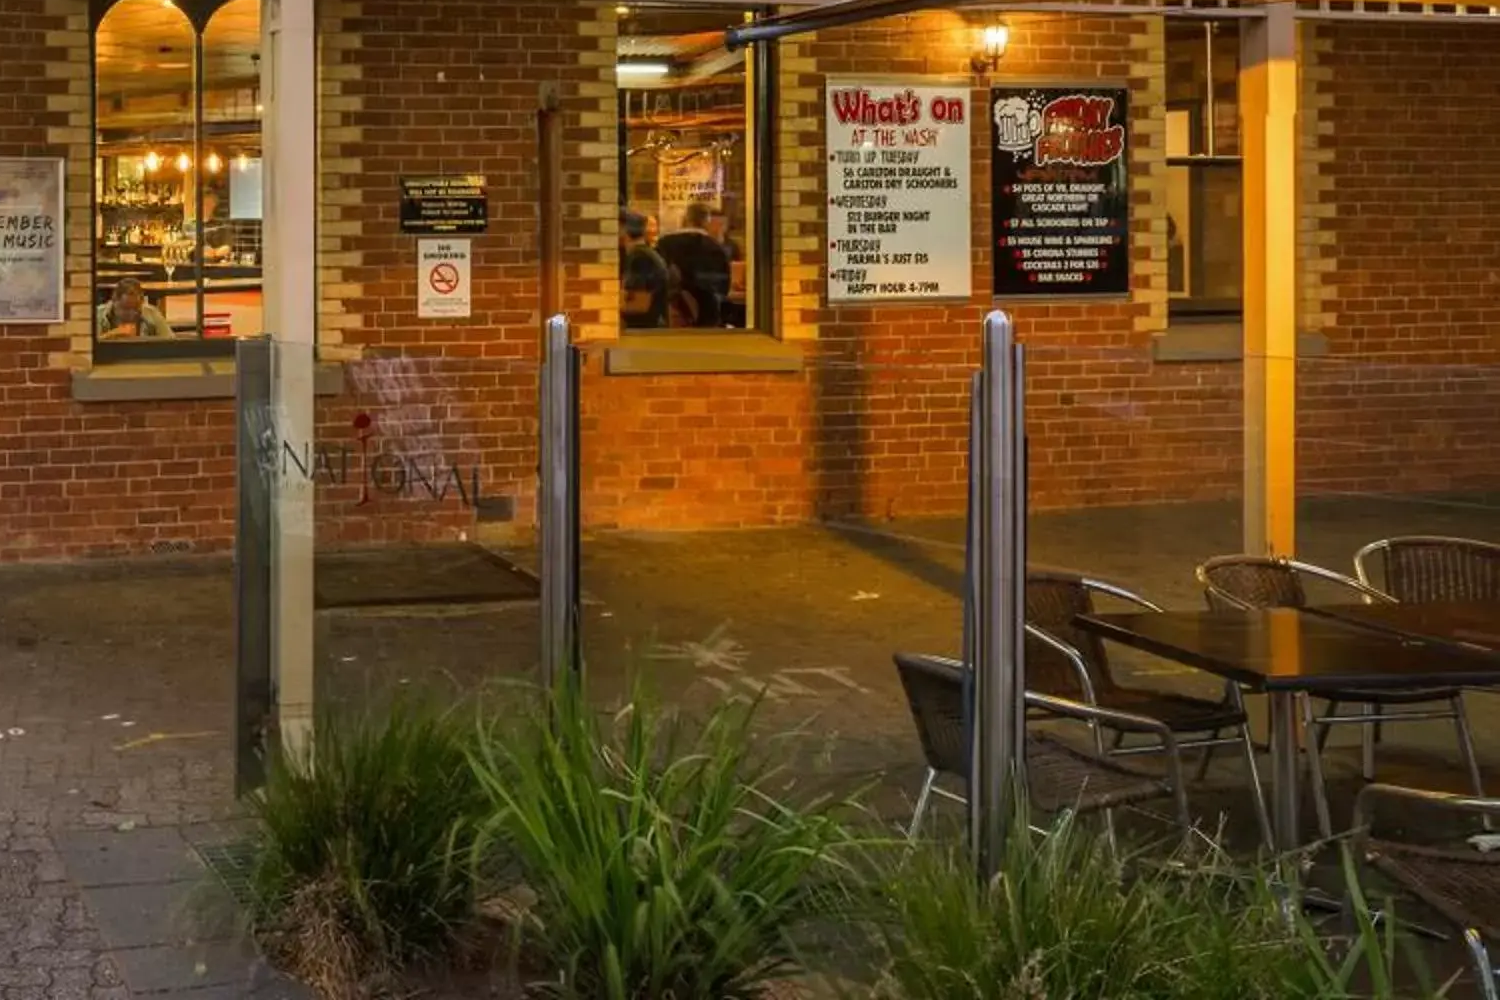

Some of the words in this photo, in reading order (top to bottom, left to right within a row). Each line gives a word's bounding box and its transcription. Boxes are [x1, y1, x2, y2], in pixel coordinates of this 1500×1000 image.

[832, 88, 921, 126] What's
[930, 95, 965, 125] on
[851, 129, 867, 146] AT
[874, 129, 896, 147] THE
[863, 151, 876, 163] UP
[881, 151, 920, 164] TUESDAY
[857, 167, 897, 177] CARLTON
[898, 167, 941, 177] DRAUGHT
[843, 179, 883, 189] CARLTON
[885, 179, 902, 189] DRY
[905, 179, 957, 189] SCHOONERS
[1024, 184, 1042, 193] POTS
[836, 195, 888, 208] WEDNESDAY
[1022, 194, 1045, 202] GREAT
[1047, 194, 1086, 202] NORTHERN
[1032, 204, 1066, 212] CASCADE
[864, 211, 900, 221] BURGER
[902, 211, 931, 221] NIGHT
[860, 224, 875, 234] THE
[878, 224, 897, 234] BAR
[4, 233, 55, 249] MUSIC
[837, 240, 882, 252] THURSDAY
[892, 254, 912, 264] JUST
[836, 270, 867, 282] FRIDAY
[847, 284, 877, 294] HAPPY
[283, 413, 494, 509] NATIONAL
